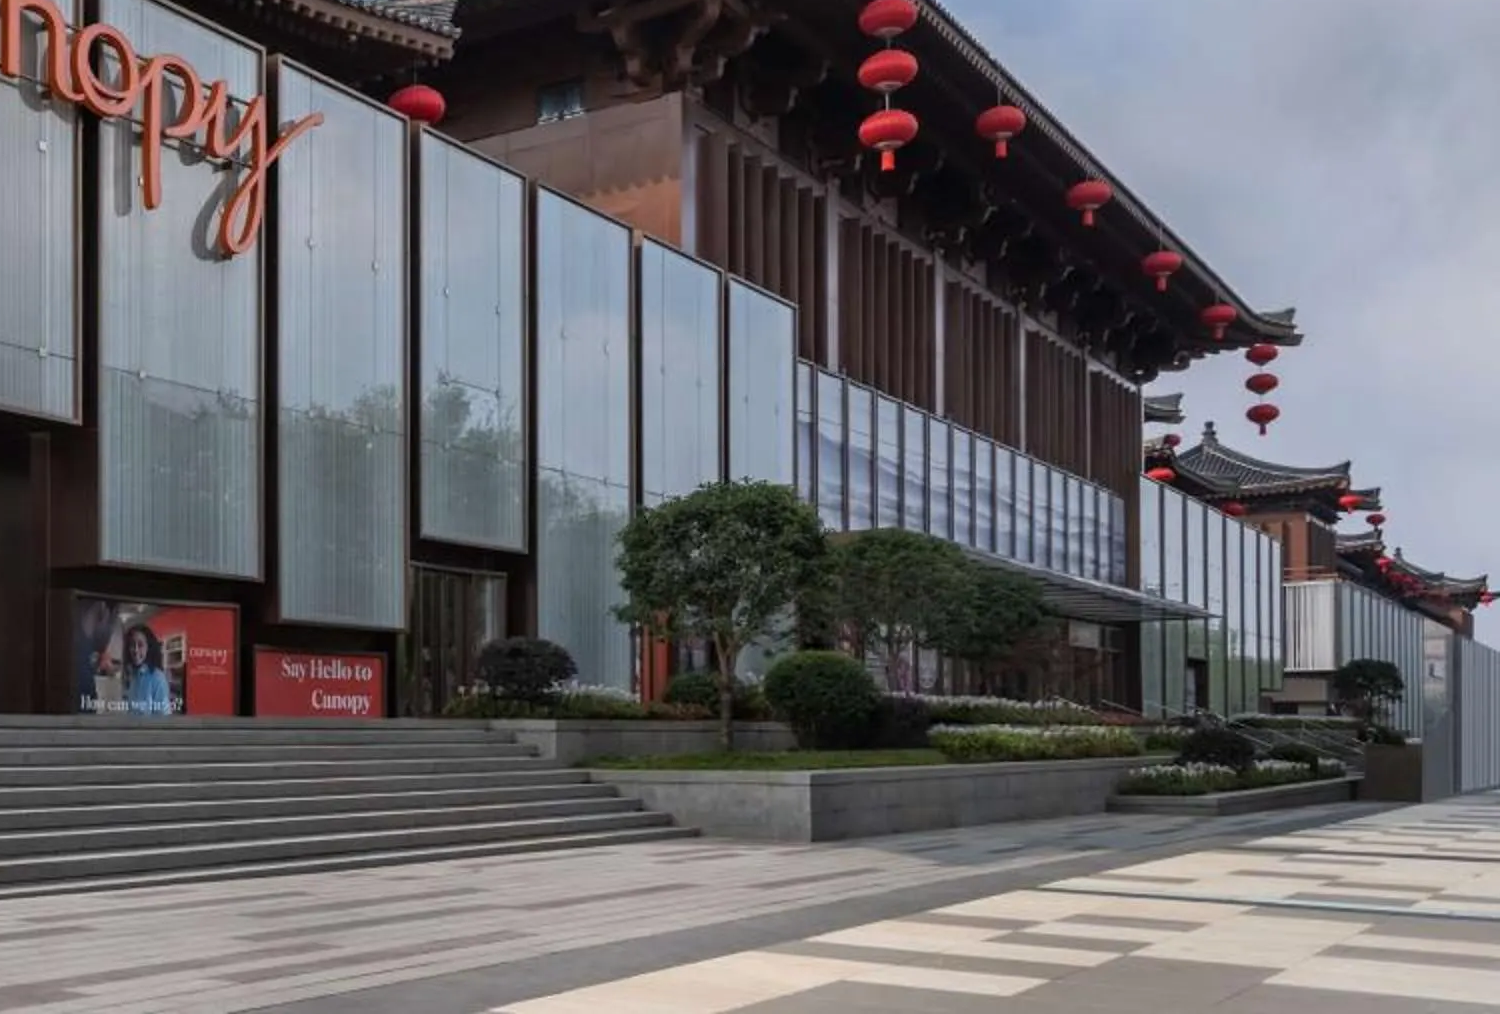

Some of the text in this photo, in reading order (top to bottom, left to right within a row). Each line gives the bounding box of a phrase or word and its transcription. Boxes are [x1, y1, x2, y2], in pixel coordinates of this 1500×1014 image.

[281, 655, 373, 683] Say Hello to
[80, 694, 105, 711] How
[107, 700, 129, 711] can
[311, 688, 370, 715] Canopy
